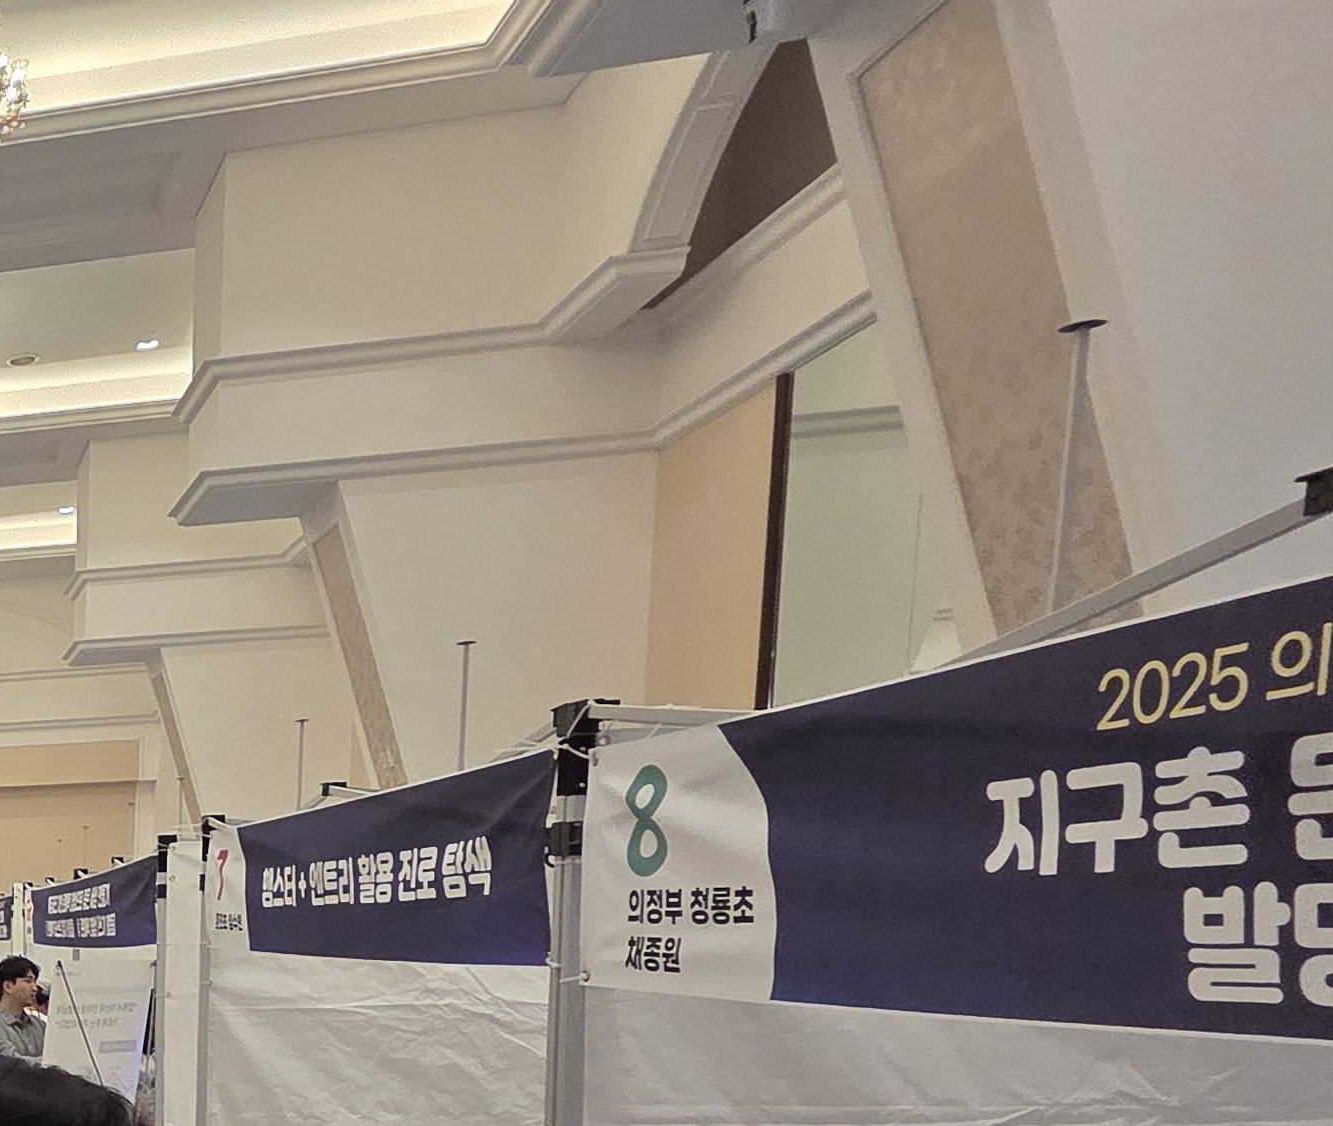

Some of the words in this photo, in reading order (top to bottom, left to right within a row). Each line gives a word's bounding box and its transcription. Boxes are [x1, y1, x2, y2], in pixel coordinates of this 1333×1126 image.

[1097, 642, 1250, 731] 2025
[625, 764, 668, 877] 8
[985, 746, 1251, 876] 지구촌
[309, 857, 354, 905] 엔트리
[357, 852, 394, 903] 활용
[398, 847, 438, 901] 진로
[442, 836, 492, 898] 탐색
[628, 889, 683, 925] 의정부
[690, 886, 754, 925] 청룡초
[625, 936, 681, 973] 채종원
